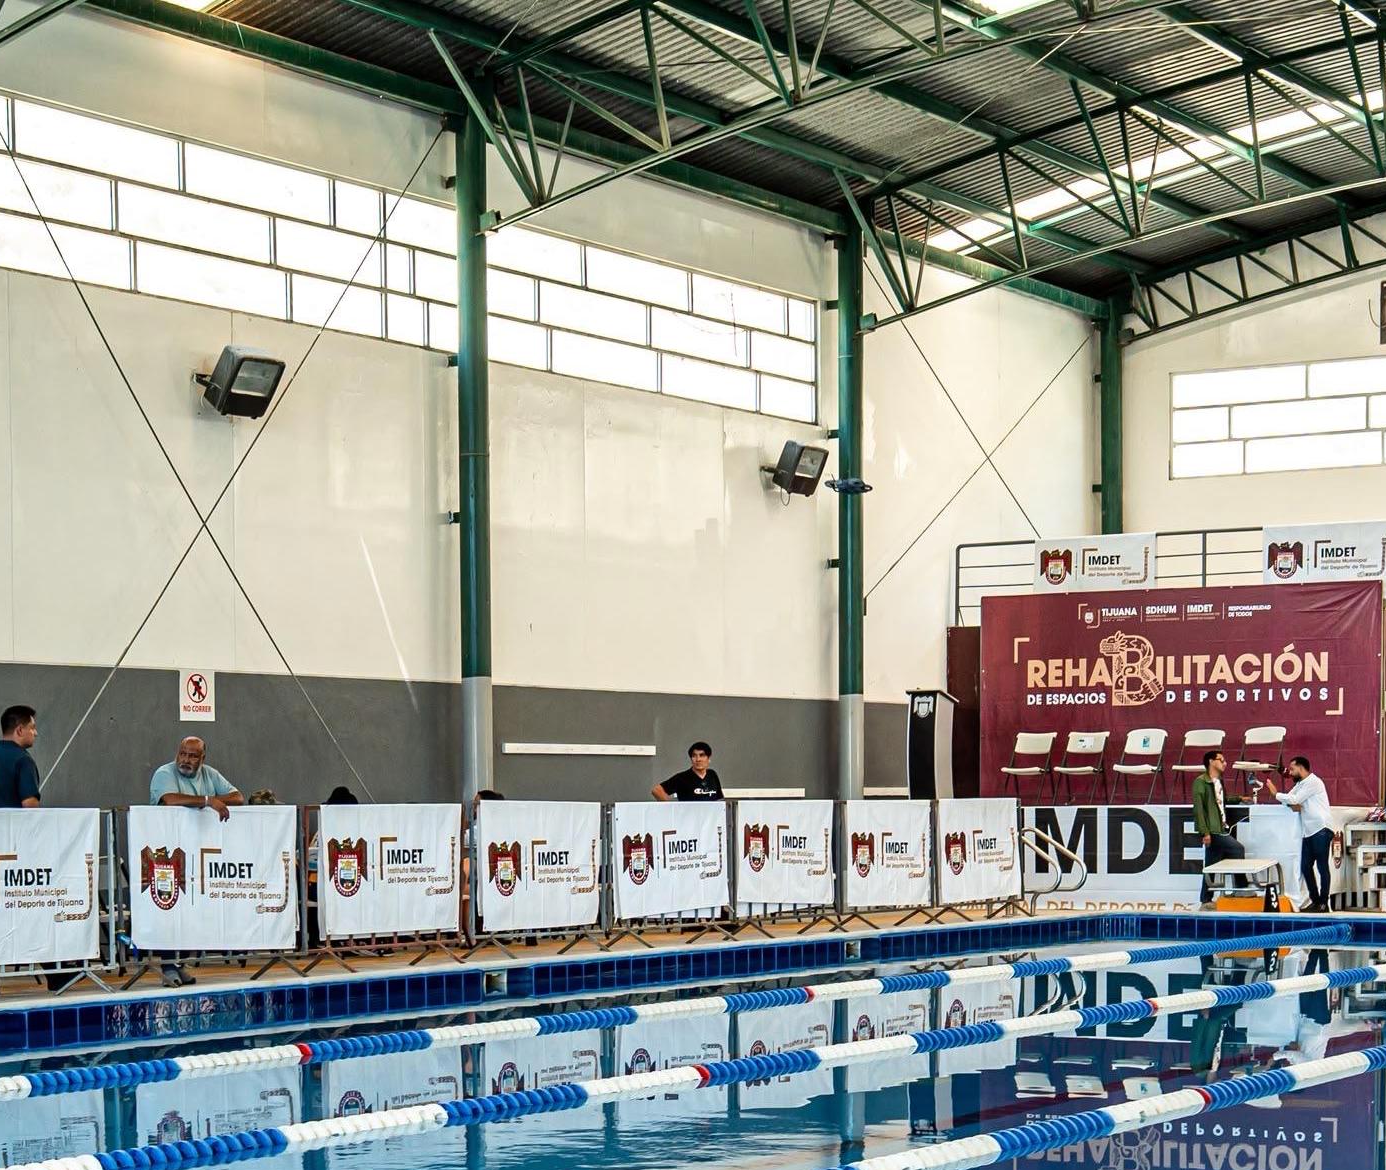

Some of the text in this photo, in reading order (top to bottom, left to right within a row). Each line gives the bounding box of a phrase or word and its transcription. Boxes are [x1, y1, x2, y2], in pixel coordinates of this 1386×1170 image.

[1321, 547, 1356, 557] IMDET
[1089, 556, 1120, 565] IMDET
[1102, 608, 1137, 616] TIJUANA
[1146, 606, 1176, 614] SDHUM
[1187, 604, 1213, 613] IMDET
[1027, 692, 1106, 705] DE ESPACIOS
[1166, 687, 1328, 702] DEPORTIVOS
[669, 840, 697, 854] IMDET
[782, 836, 807, 848] IMDET
[886, 842, 908, 854] IMDET
[978, 838, 996, 850] IMDET
[387, 849, 423, 864] IMDET
[538, 851, 569, 865] IMDET
[209, 863, 253, 878] IMDET
[5, 869, 52, 886] IMDET
[34, 888, 67, 896] Municipal
[1270, 887, 1277, 901] 5
[18, 901, 45, 909] Deporte
[58, 899, 84, 907] Tijuana
